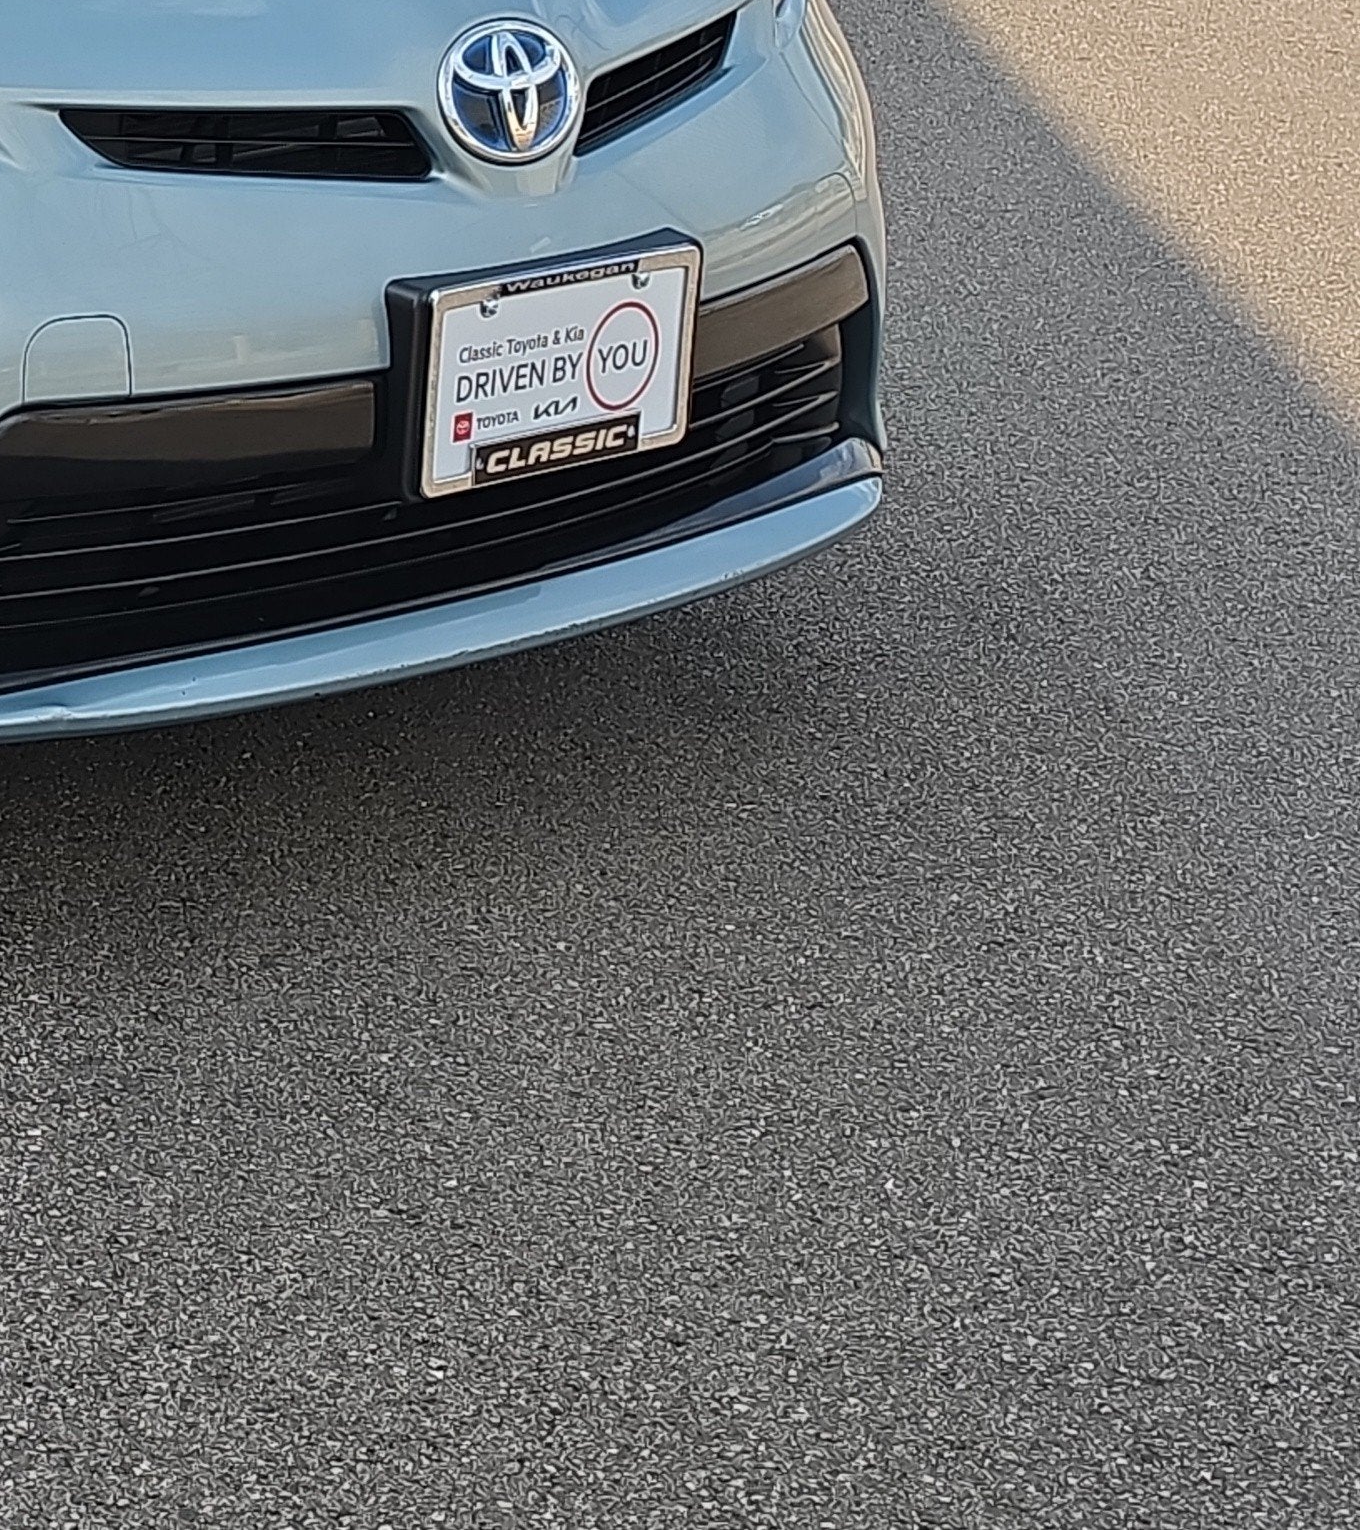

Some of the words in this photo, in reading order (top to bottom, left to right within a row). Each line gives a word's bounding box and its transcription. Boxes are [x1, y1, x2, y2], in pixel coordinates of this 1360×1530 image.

[506, 261, 635, 293] Waukegan
[459, 341, 504, 363] Classic
[507, 334, 548, 355] Toyota
[552, 330, 561, 346] &
[565, 326, 585, 342] Kia
[456, 359, 546, 403] DRIVEN
[552, 352, 583, 384] BY
[598, 340, 648, 374] YOU
[476, 410, 520, 431] TOYOTA
[486, 425, 628, 474] CLASSIC
